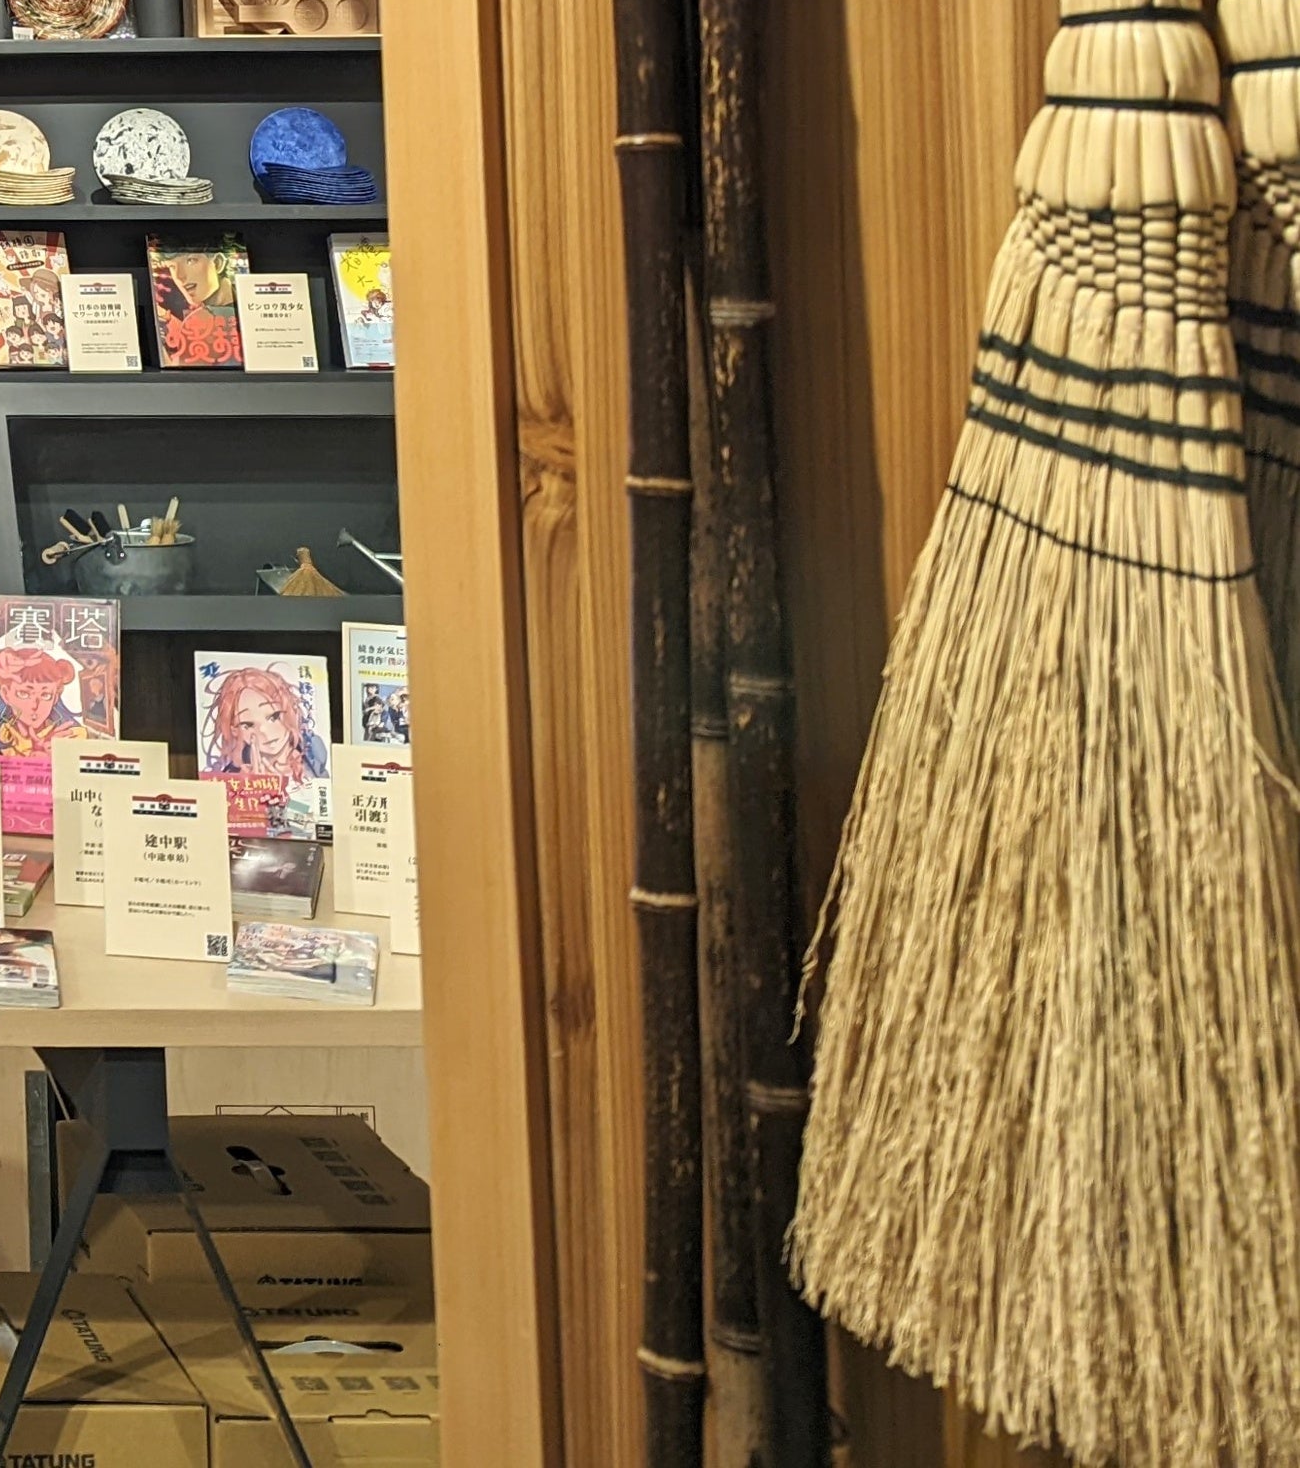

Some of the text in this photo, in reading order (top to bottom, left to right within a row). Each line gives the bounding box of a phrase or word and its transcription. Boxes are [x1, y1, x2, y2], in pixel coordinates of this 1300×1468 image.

[354, 808, 388, 823] 引渡
[144, 833, 188, 850] 途中駅
[9, 1453, 96, 1468] TATUNG
